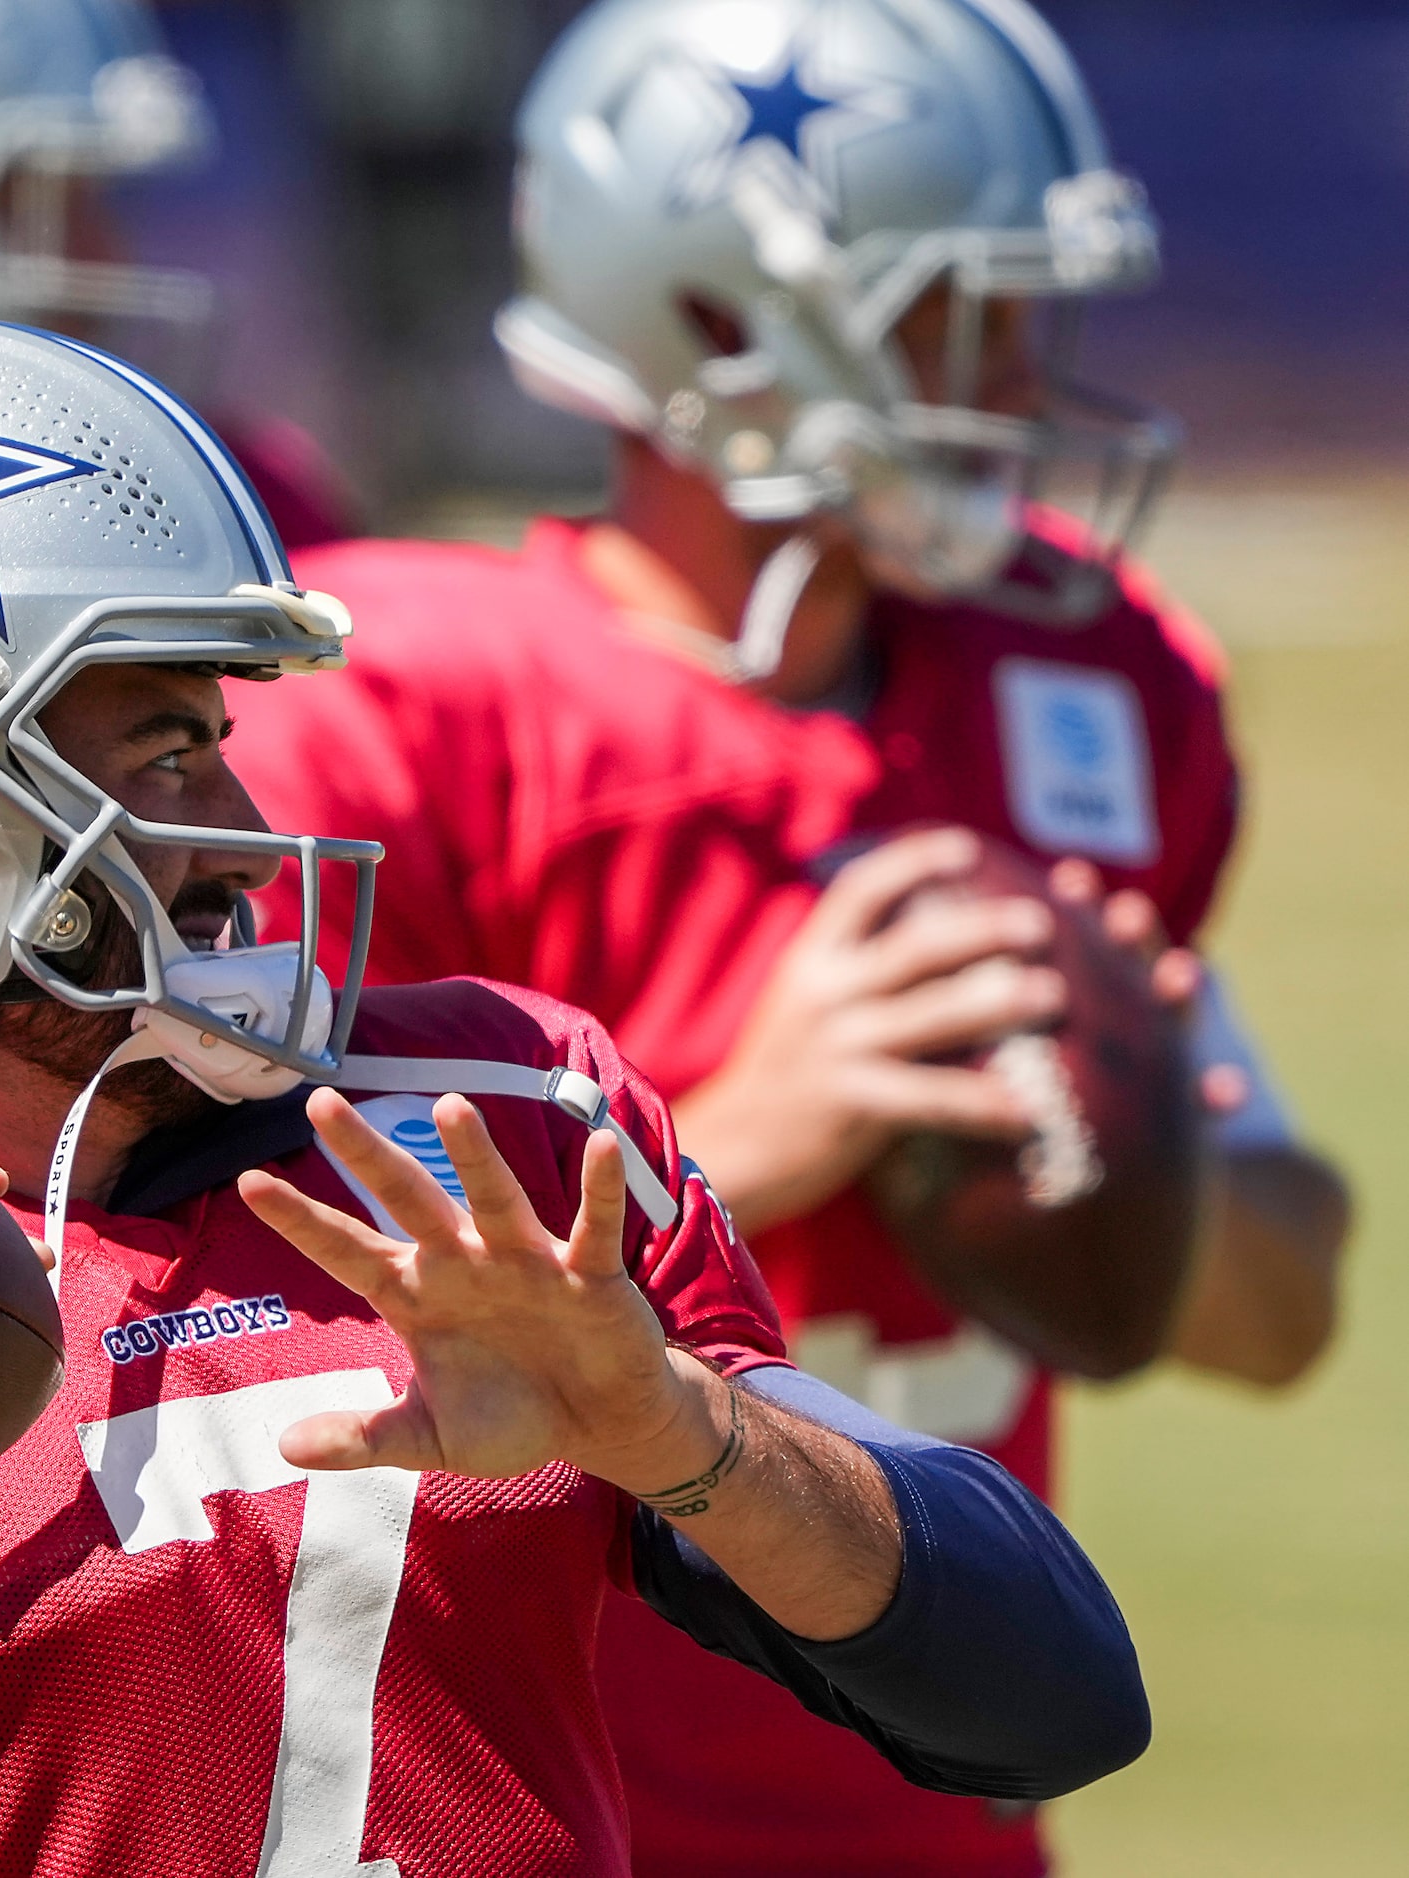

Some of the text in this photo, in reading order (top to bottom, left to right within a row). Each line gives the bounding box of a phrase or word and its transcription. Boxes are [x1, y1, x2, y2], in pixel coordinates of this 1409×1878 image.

[50, 1123, 75, 1195] SPORT
[101, 1294, 292, 1364] COWBOYS
[76, 1367, 421, 1878] 7
